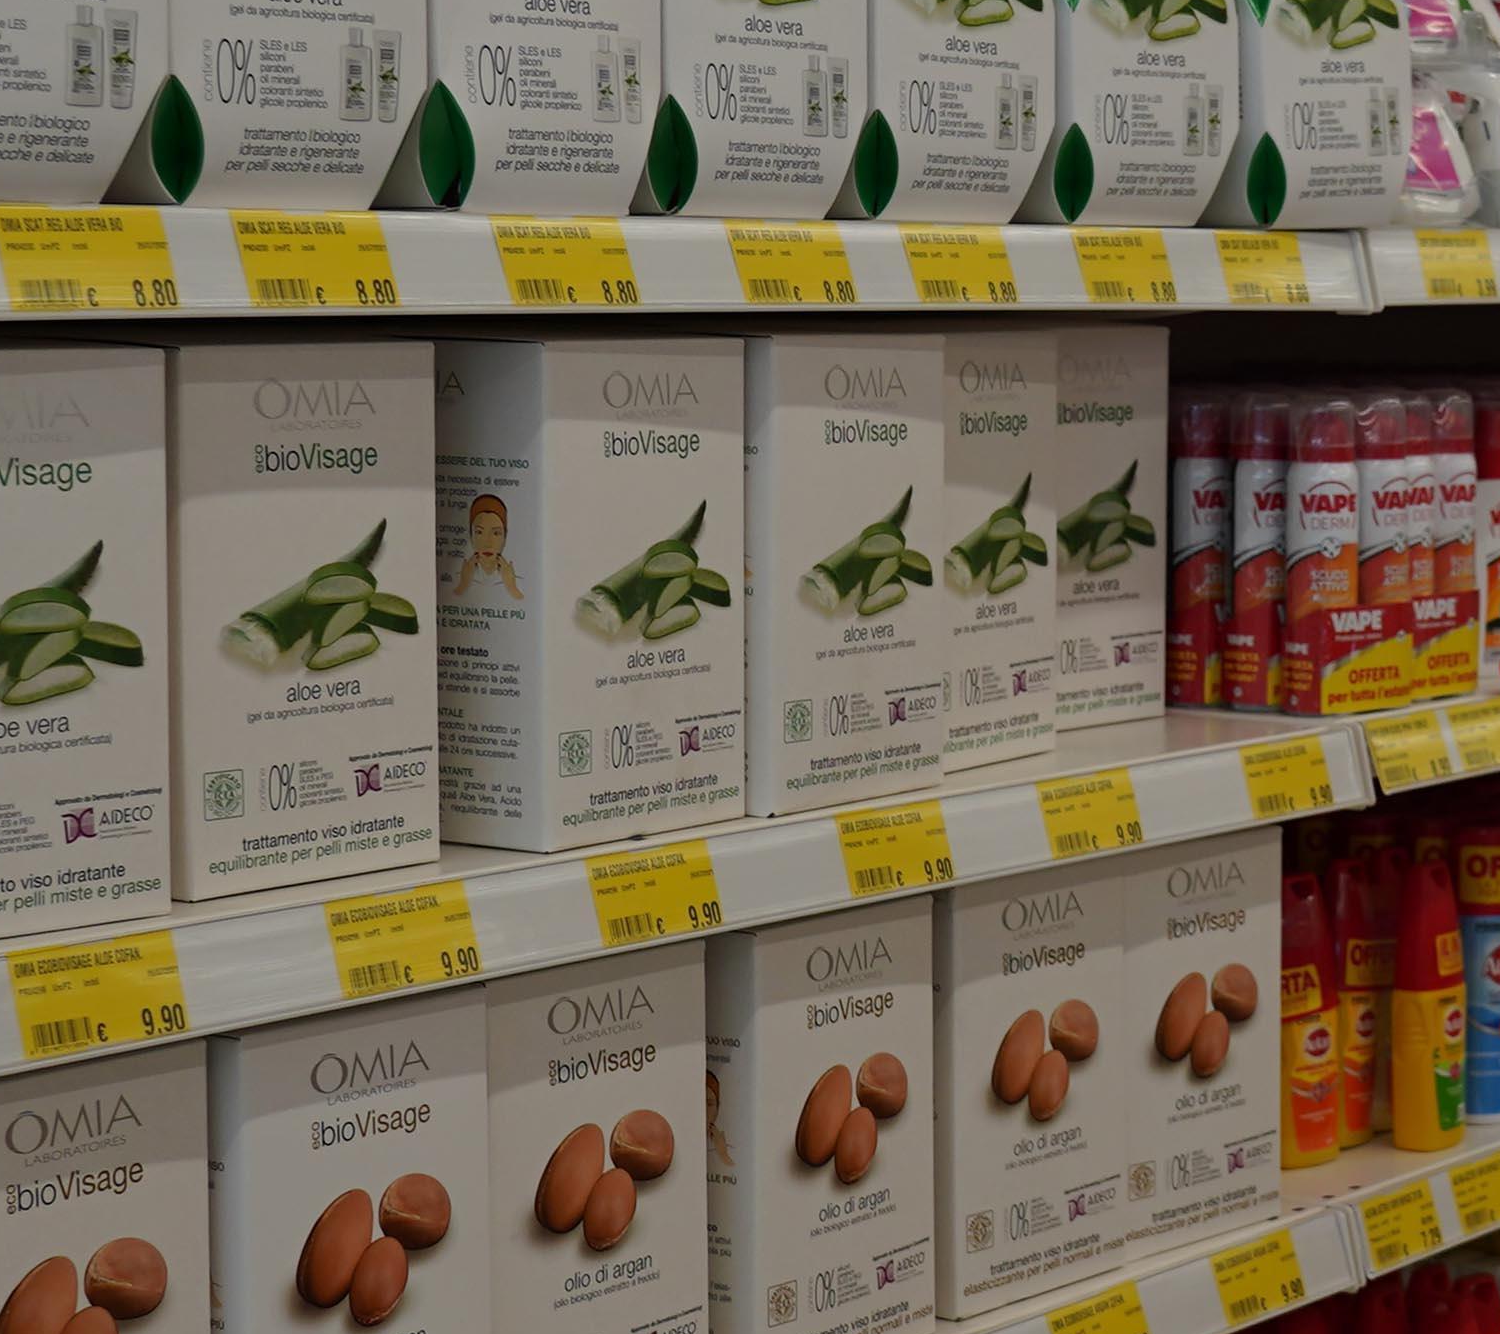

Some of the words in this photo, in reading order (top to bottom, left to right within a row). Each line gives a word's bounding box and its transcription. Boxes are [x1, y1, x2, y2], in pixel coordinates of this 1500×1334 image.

[611, 429, 700, 459] bioVisage
[1300, 493, 1357, 513] VAPE
[1331, 610, 1383, 632] VAPE
[1349, 666, 1400, 683] OFFERTA
[17, 1160, 144, 1213] bioVisage
